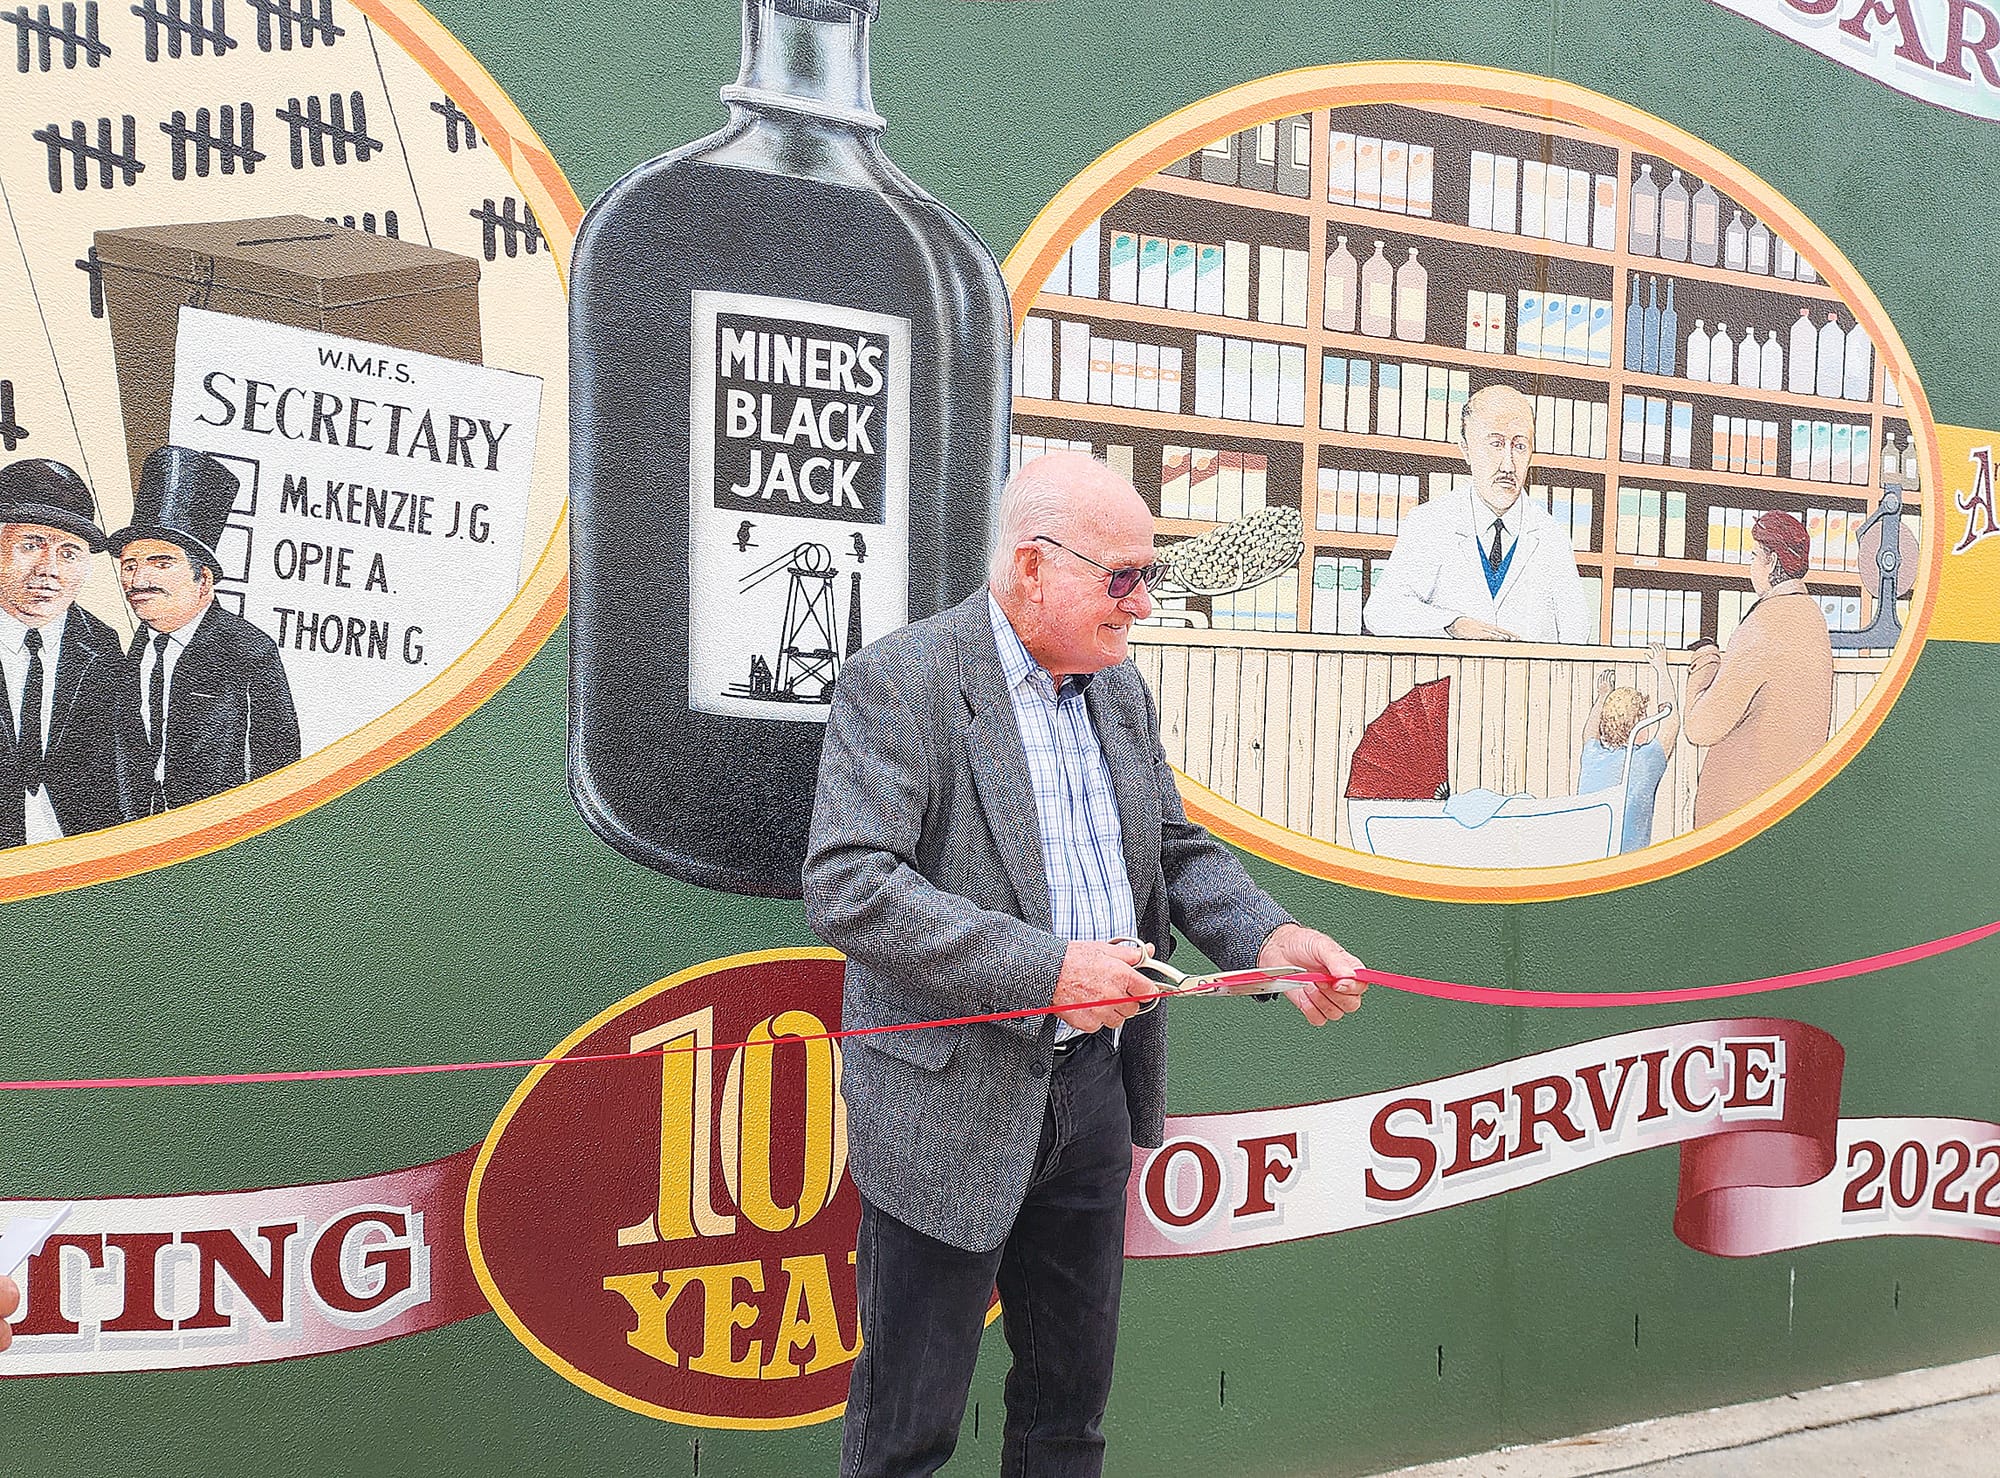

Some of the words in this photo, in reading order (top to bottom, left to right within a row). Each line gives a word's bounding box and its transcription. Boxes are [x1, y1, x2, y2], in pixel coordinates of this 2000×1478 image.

[1785, 0, 2000, 86] AR
[318, 347, 416, 384] W.M.F.S.
[720, 327, 883, 396] MINER'S
[194, 371, 512, 471] SECRETARY
[726, 390, 876, 455] BLACK
[279, 473, 435, 536] McKENZIE
[445, 501, 495, 545] J.G.
[730, 450, 864, 510] JACK
[273, 538, 354, 588] OPIE
[364, 552, 397, 594] A.
[272, 607, 389, 660] THORN
[402, 625, 428, 666] G.
[1144, 1131, 1298, 1227] OF
[1364, 1042, 1777, 1201] SERVICE
[1842, 1140, 2000, 1218] 2022
[0, 1210, 412, 1336] TING
[603, 1254, 864, 1380] YEA
